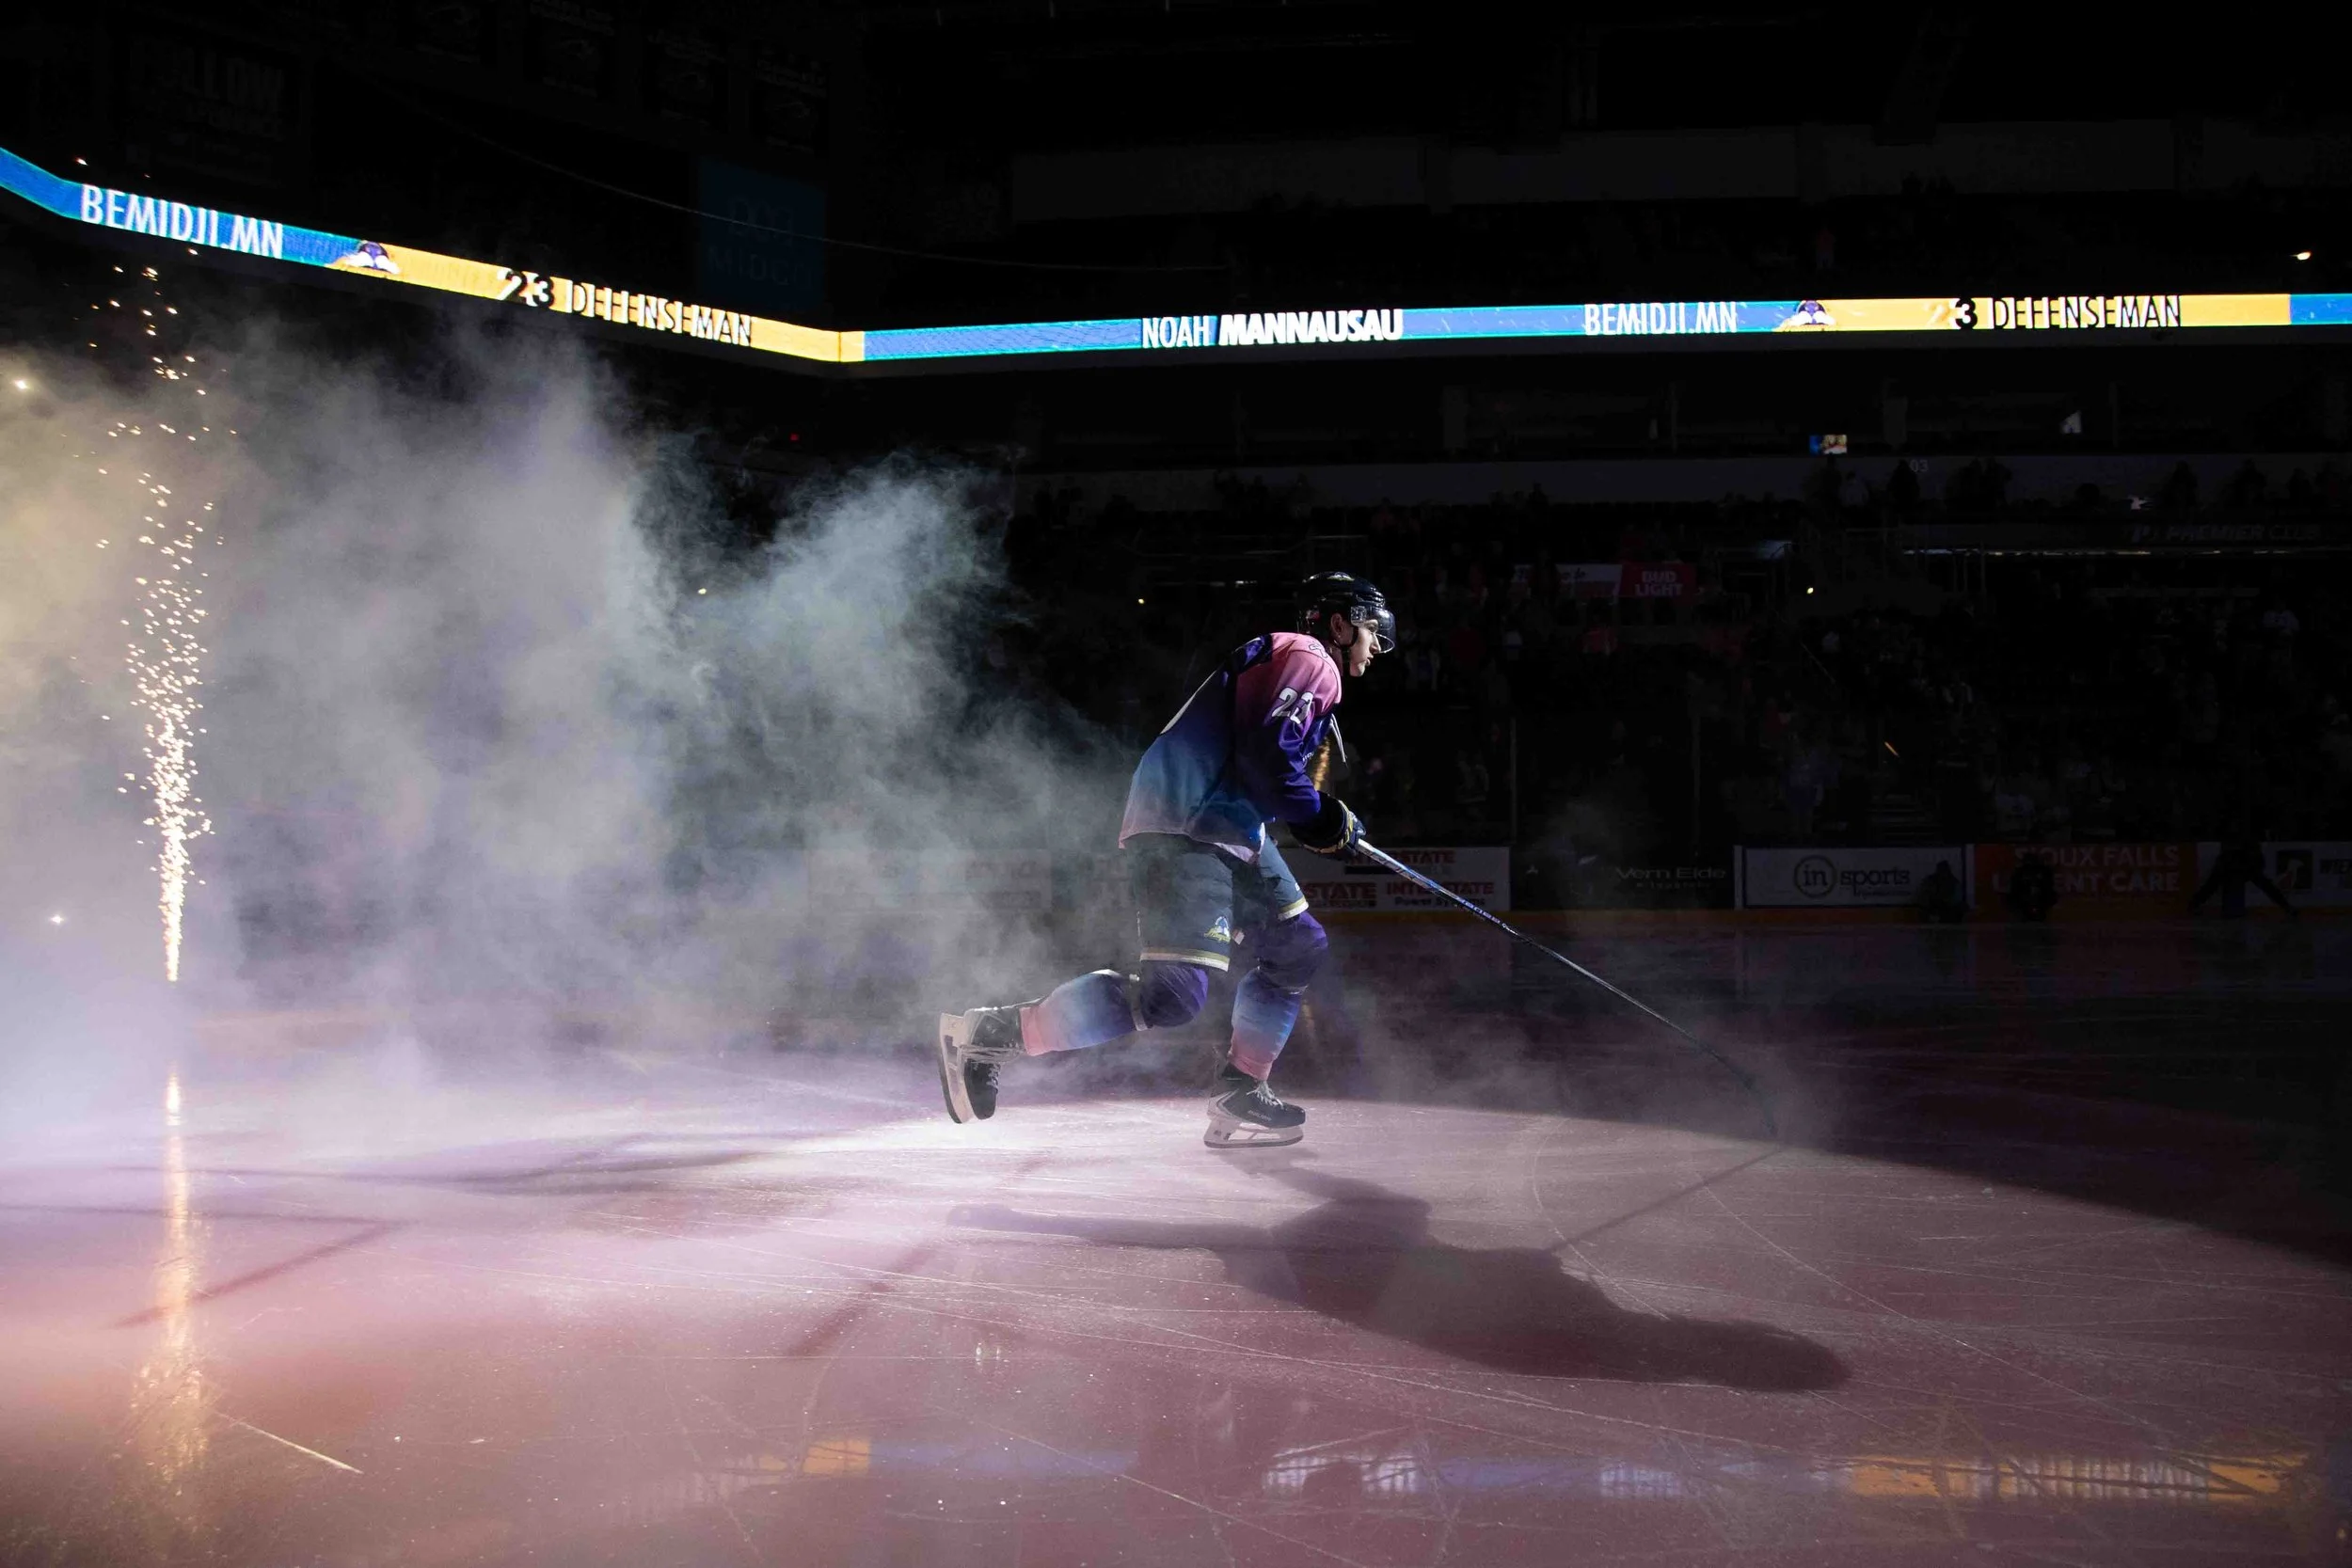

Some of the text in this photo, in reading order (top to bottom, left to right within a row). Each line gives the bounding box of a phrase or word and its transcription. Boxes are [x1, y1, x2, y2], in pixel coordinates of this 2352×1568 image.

[570, 282, 753, 348] DEFENSEMAN
[1994, 296, 2181, 329] DEFENSEMAN
[1141, 309, 1404, 349] NOAH MANNAUSAU
[2166, 524, 2321, 541] PREMIER CLUB
[1641, 570, 1677, 583] BUD
[1634, 583, 1684, 596] LIGHT
[2014, 846, 2181, 867] SOUX FALLS
[1614, 866, 1671, 879] Vern
[1804, 864, 1912, 896] in sports
[1991, 871, 2181, 894] UENT CARE
